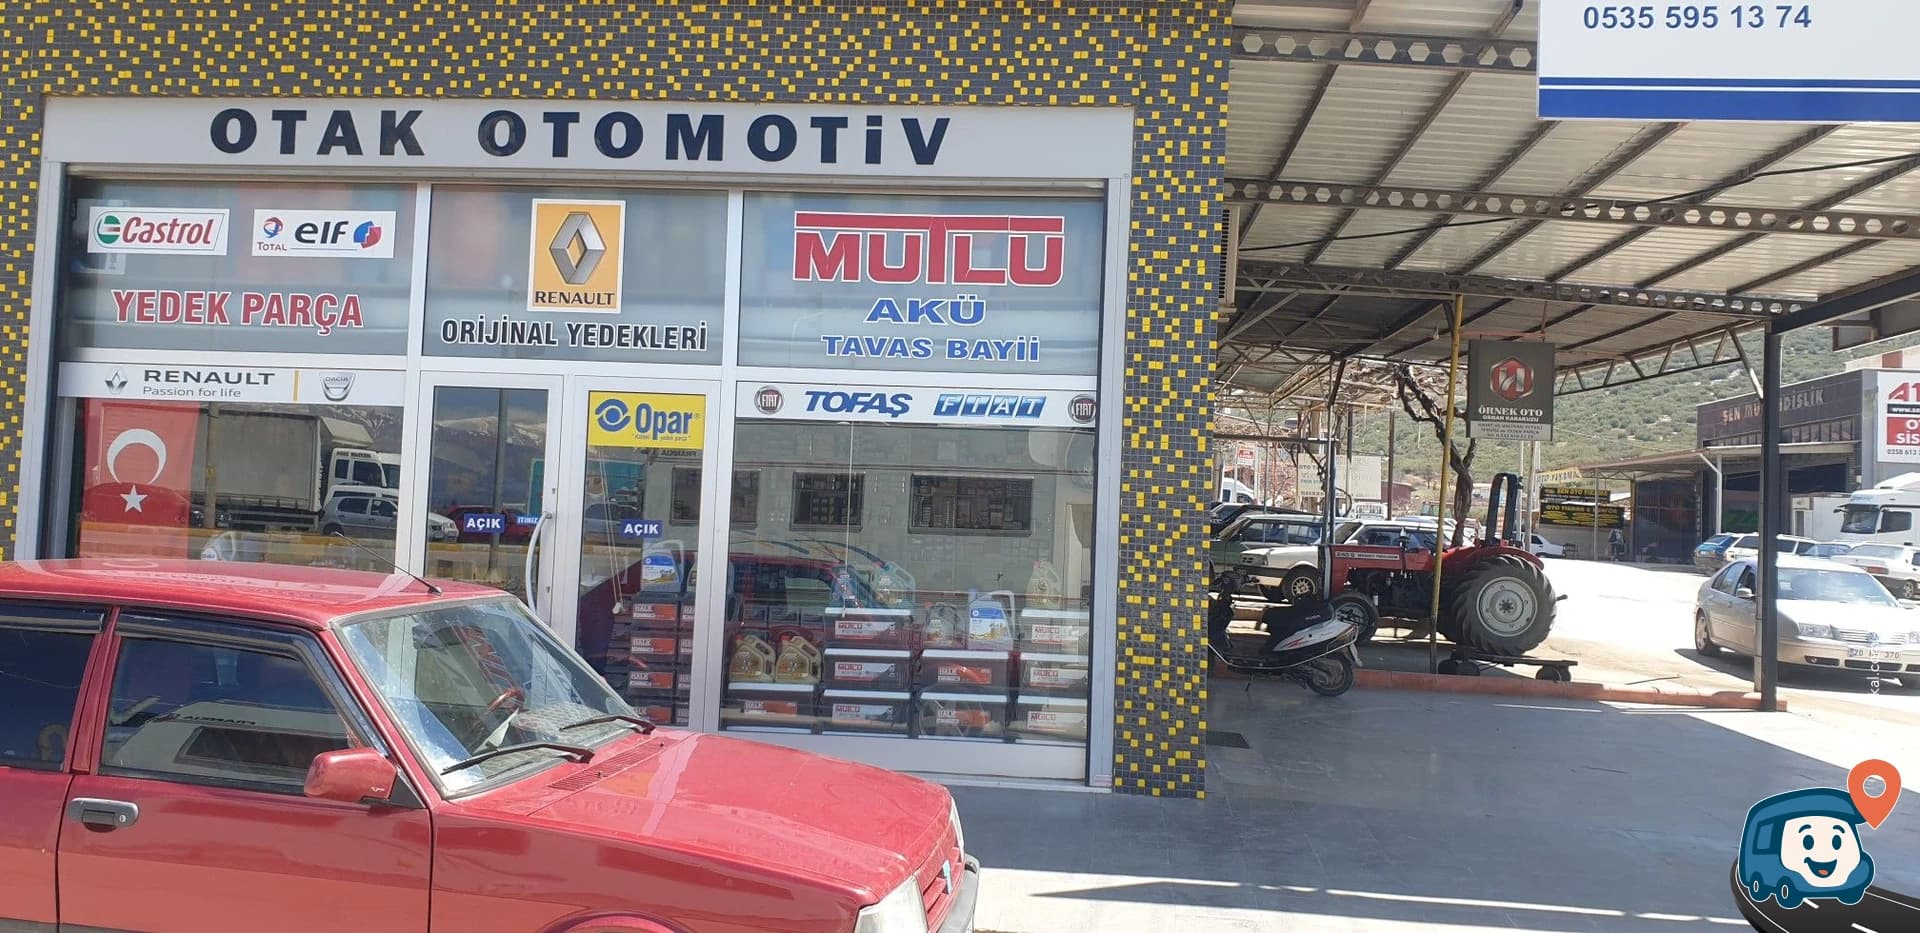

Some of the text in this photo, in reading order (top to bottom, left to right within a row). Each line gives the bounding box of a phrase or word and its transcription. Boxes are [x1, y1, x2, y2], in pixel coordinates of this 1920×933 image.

[1583, 5, 1812, 29] 0535 595 13 74
[210, 107, 425, 157] OTAK
[122, 216, 214, 245] Castrol
[294, 220, 349, 245] elf
[793, 211, 1065, 287] MUTLU
[535, 291, 615, 306] RENAULT
[864, 294, 987, 326] AKÜ
[111, 289, 364, 336] YEDEK PARÇA
[440, 314, 708, 351] ORİJİNAL YEDEKLERİ
[821, 335, 934, 359] TAVAS
[143, 369, 276, 386] RENAULT
[143, 386, 241, 399] Passion for life
[762, 393, 779, 408] FIAT
[804, 390, 913, 418] TOFAŞ
[934, 394, 1046, 418] FIAT
[1075, 402, 1095, 416] FIAT
[1478, 404, 1543, 417] ÖRNEK OTO
[635, 402, 693, 440] Opar
[466, 517, 501, 531] AÇIK
[623, 523, 659, 537] AÇIK
